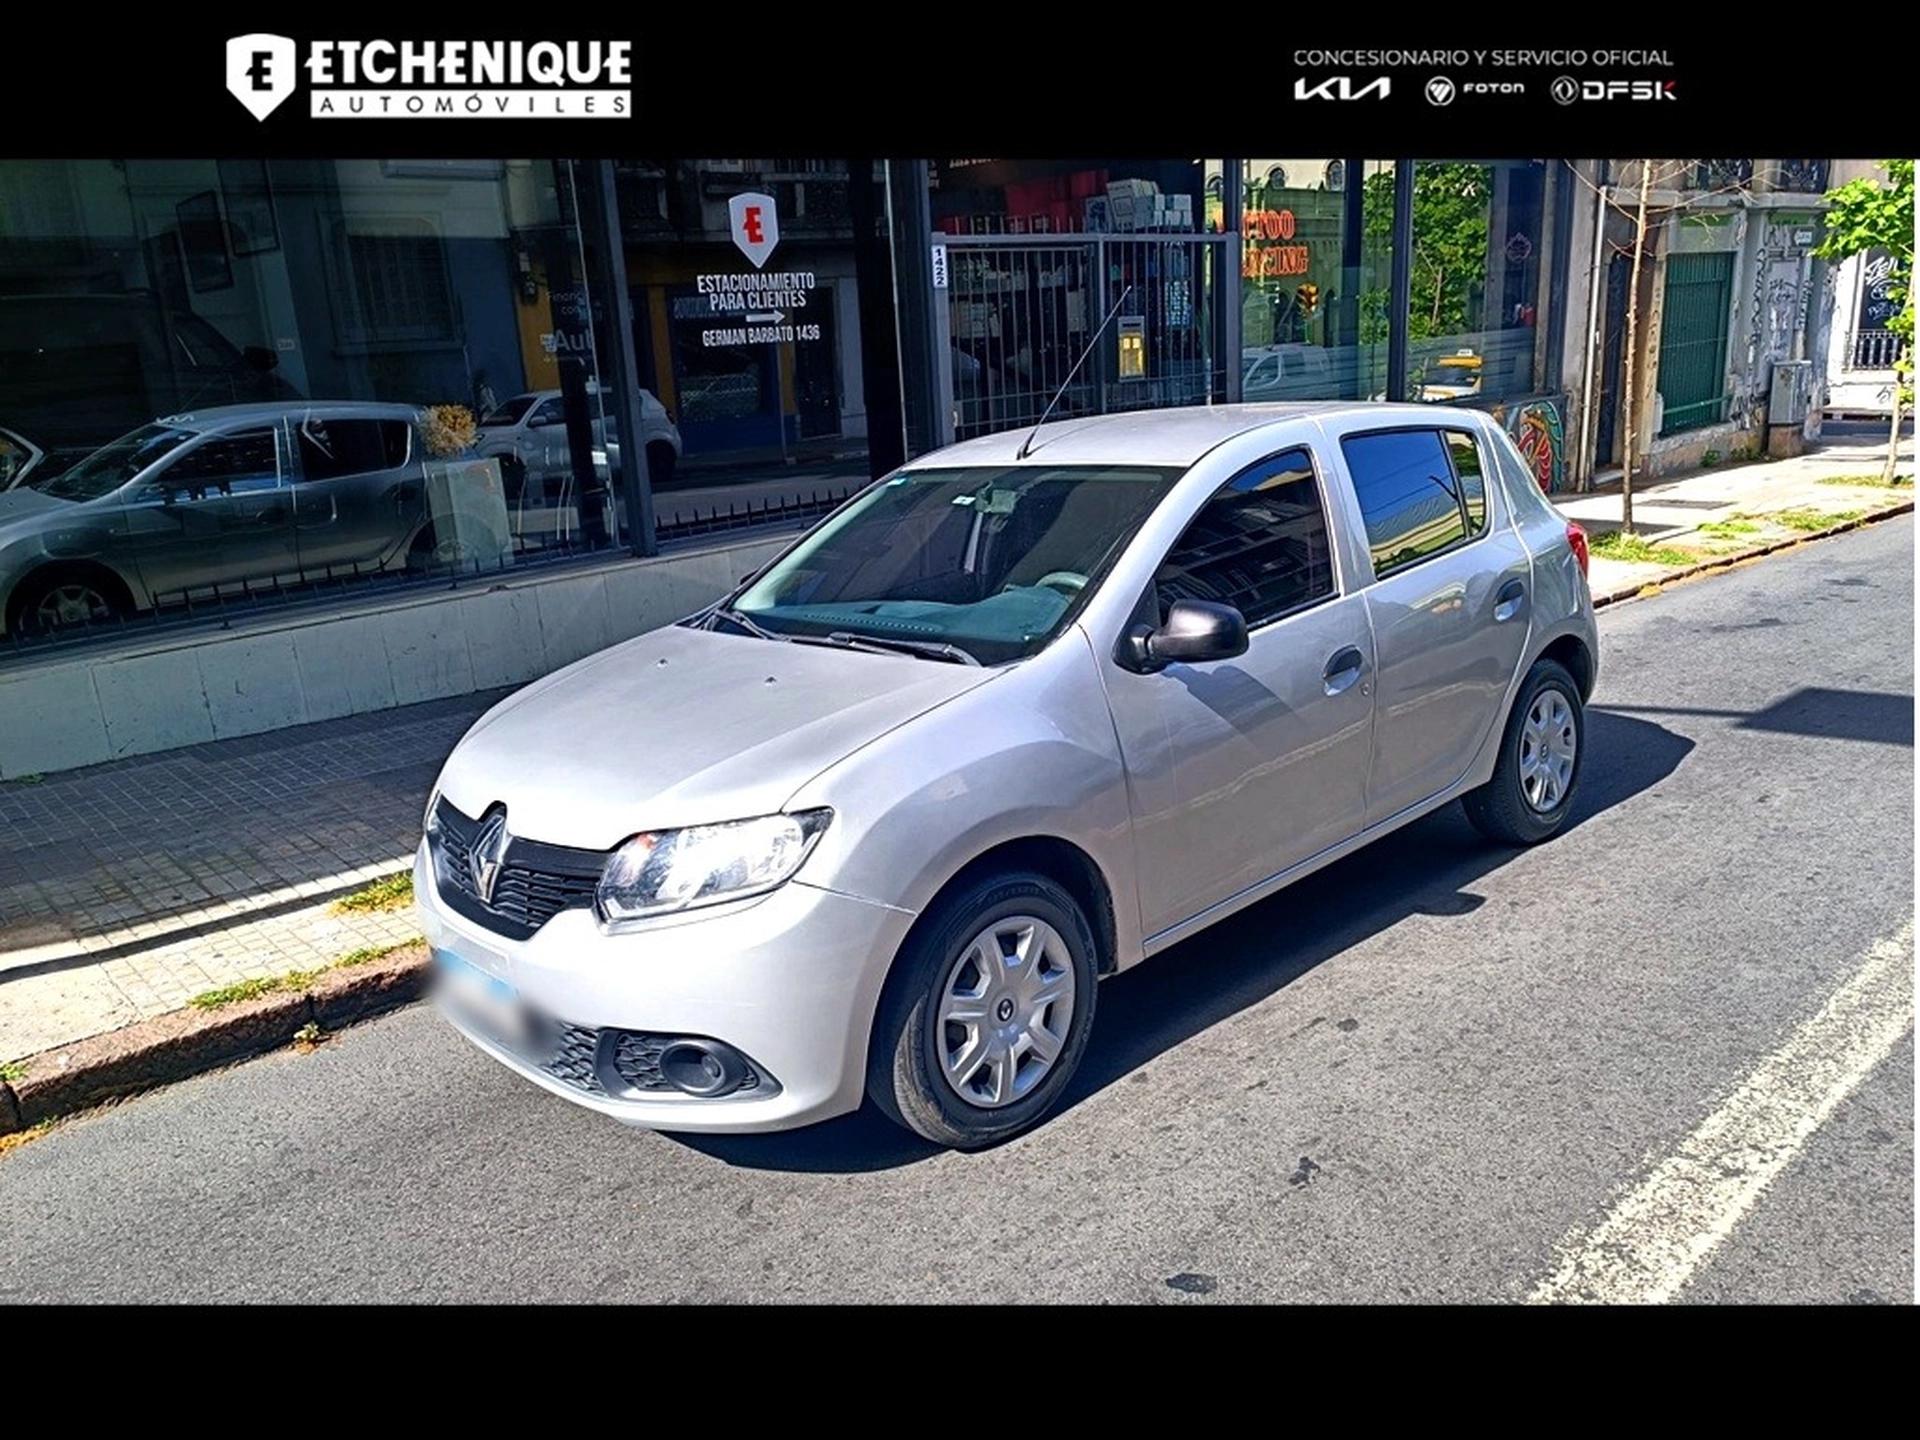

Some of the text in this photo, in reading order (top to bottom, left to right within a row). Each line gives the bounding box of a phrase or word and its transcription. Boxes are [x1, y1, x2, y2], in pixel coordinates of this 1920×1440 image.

[934, 247, 945, 286] 1422
[696, 272, 816, 293] ESTACIONAMIENTO
[709, 292, 746, 311] PARA
[747, 290, 807, 310] CLIENTES
[702, 325, 820, 347] GERMAN BARBATO 1436
